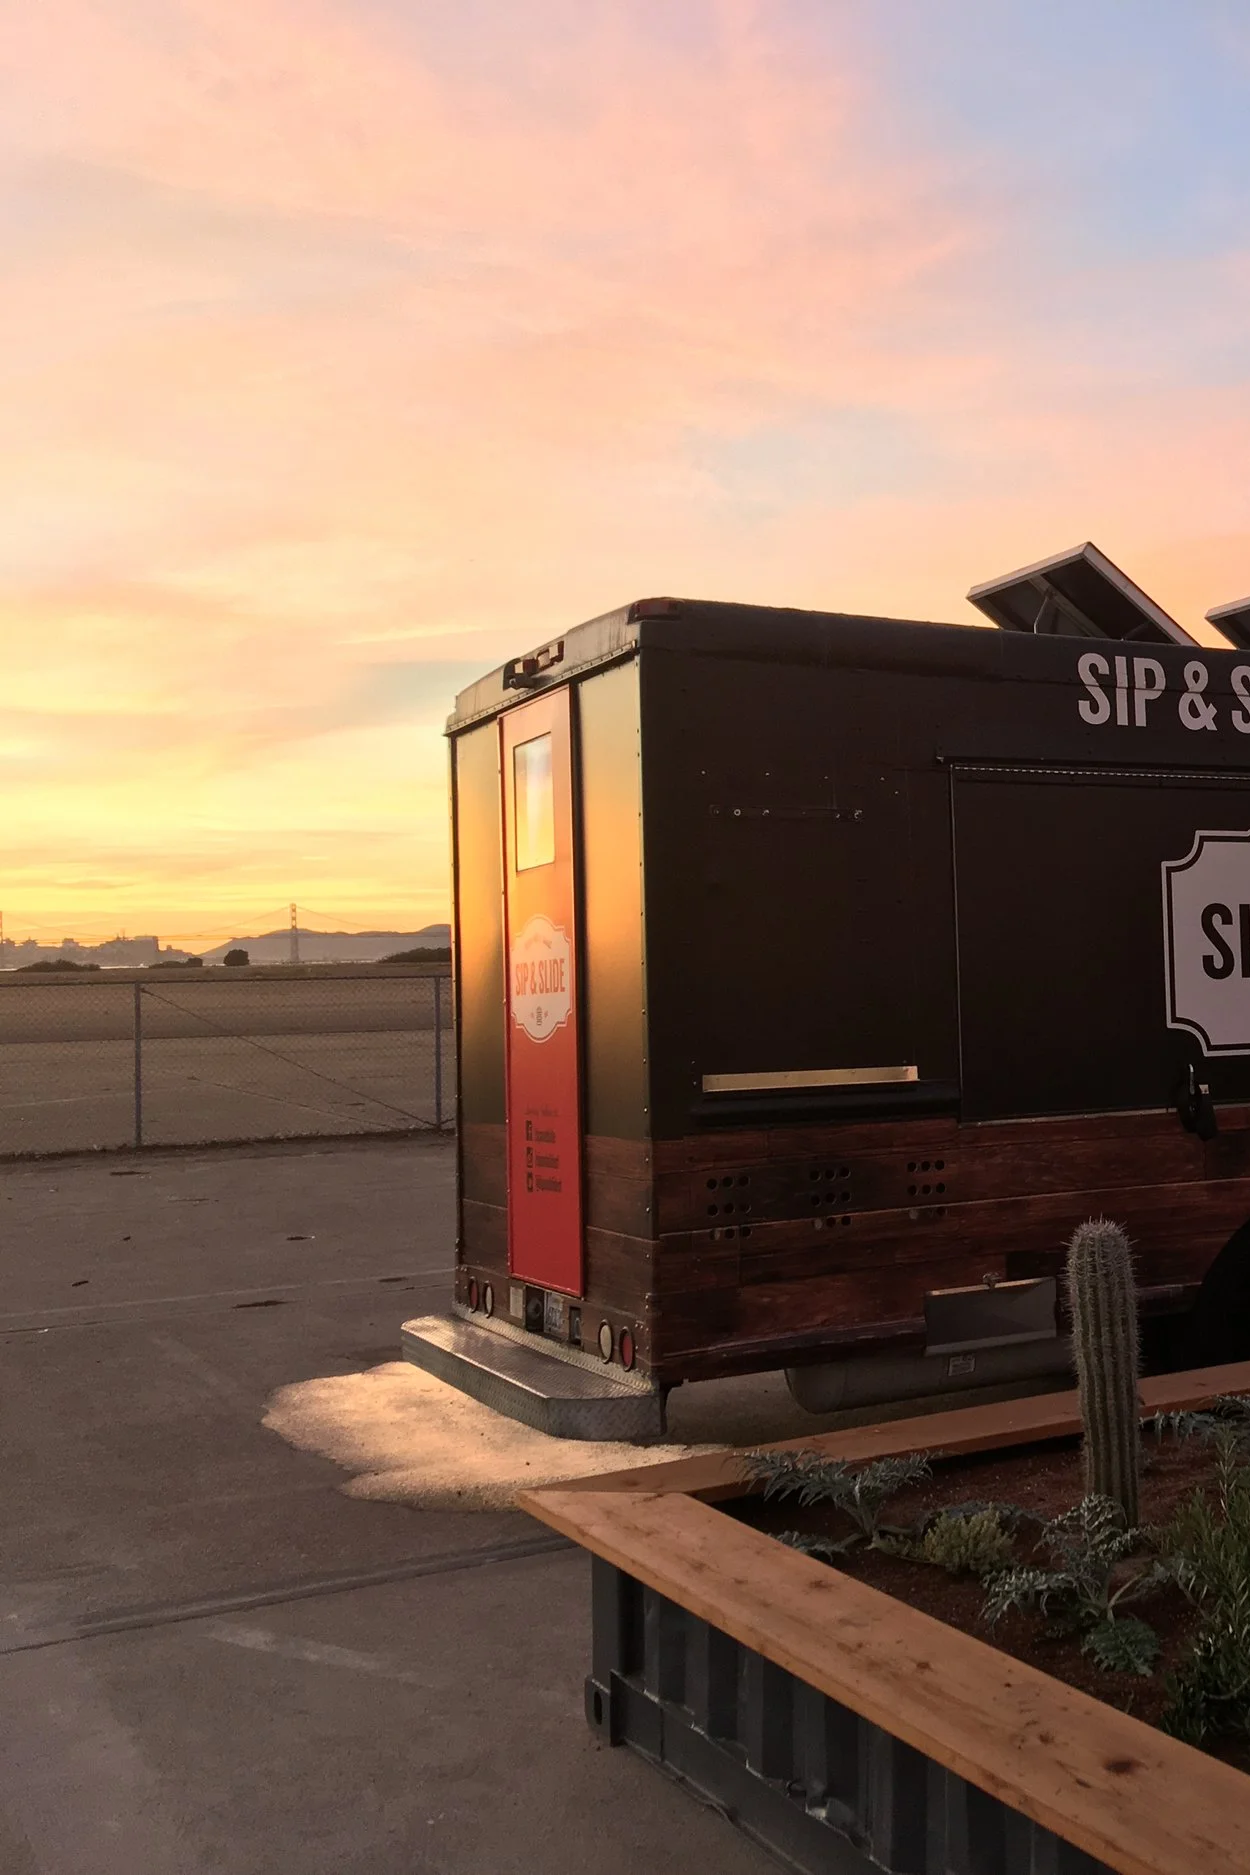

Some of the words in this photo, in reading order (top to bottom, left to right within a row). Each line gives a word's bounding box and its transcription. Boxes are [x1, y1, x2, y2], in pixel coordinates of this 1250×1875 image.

[1077, 652, 1166, 727] SIP
[1178, 660, 1218, 731] &
[515, 962, 529, 996] SIP
[530, 961, 537, 995] &
[538, 958, 566, 994] SLIDE
